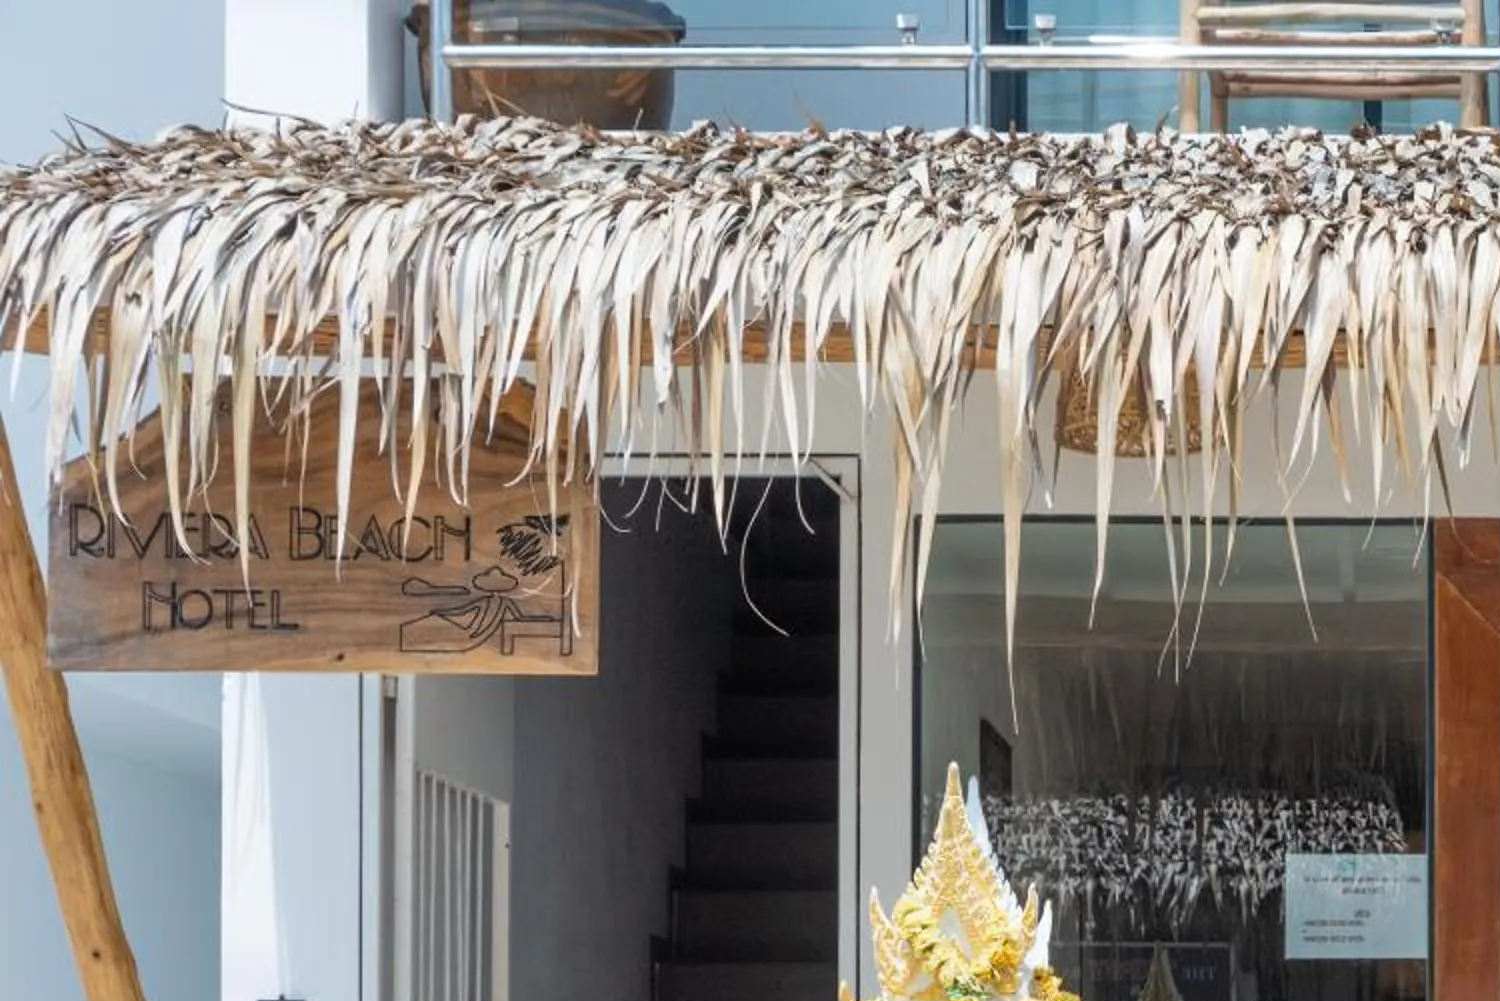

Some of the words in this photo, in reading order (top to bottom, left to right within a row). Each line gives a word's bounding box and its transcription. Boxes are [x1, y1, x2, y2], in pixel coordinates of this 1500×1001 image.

[69, 503, 271, 560] RIVIERA
[290, 505, 471, 562] BEACH
[143, 580, 300, 631] HOTEL
